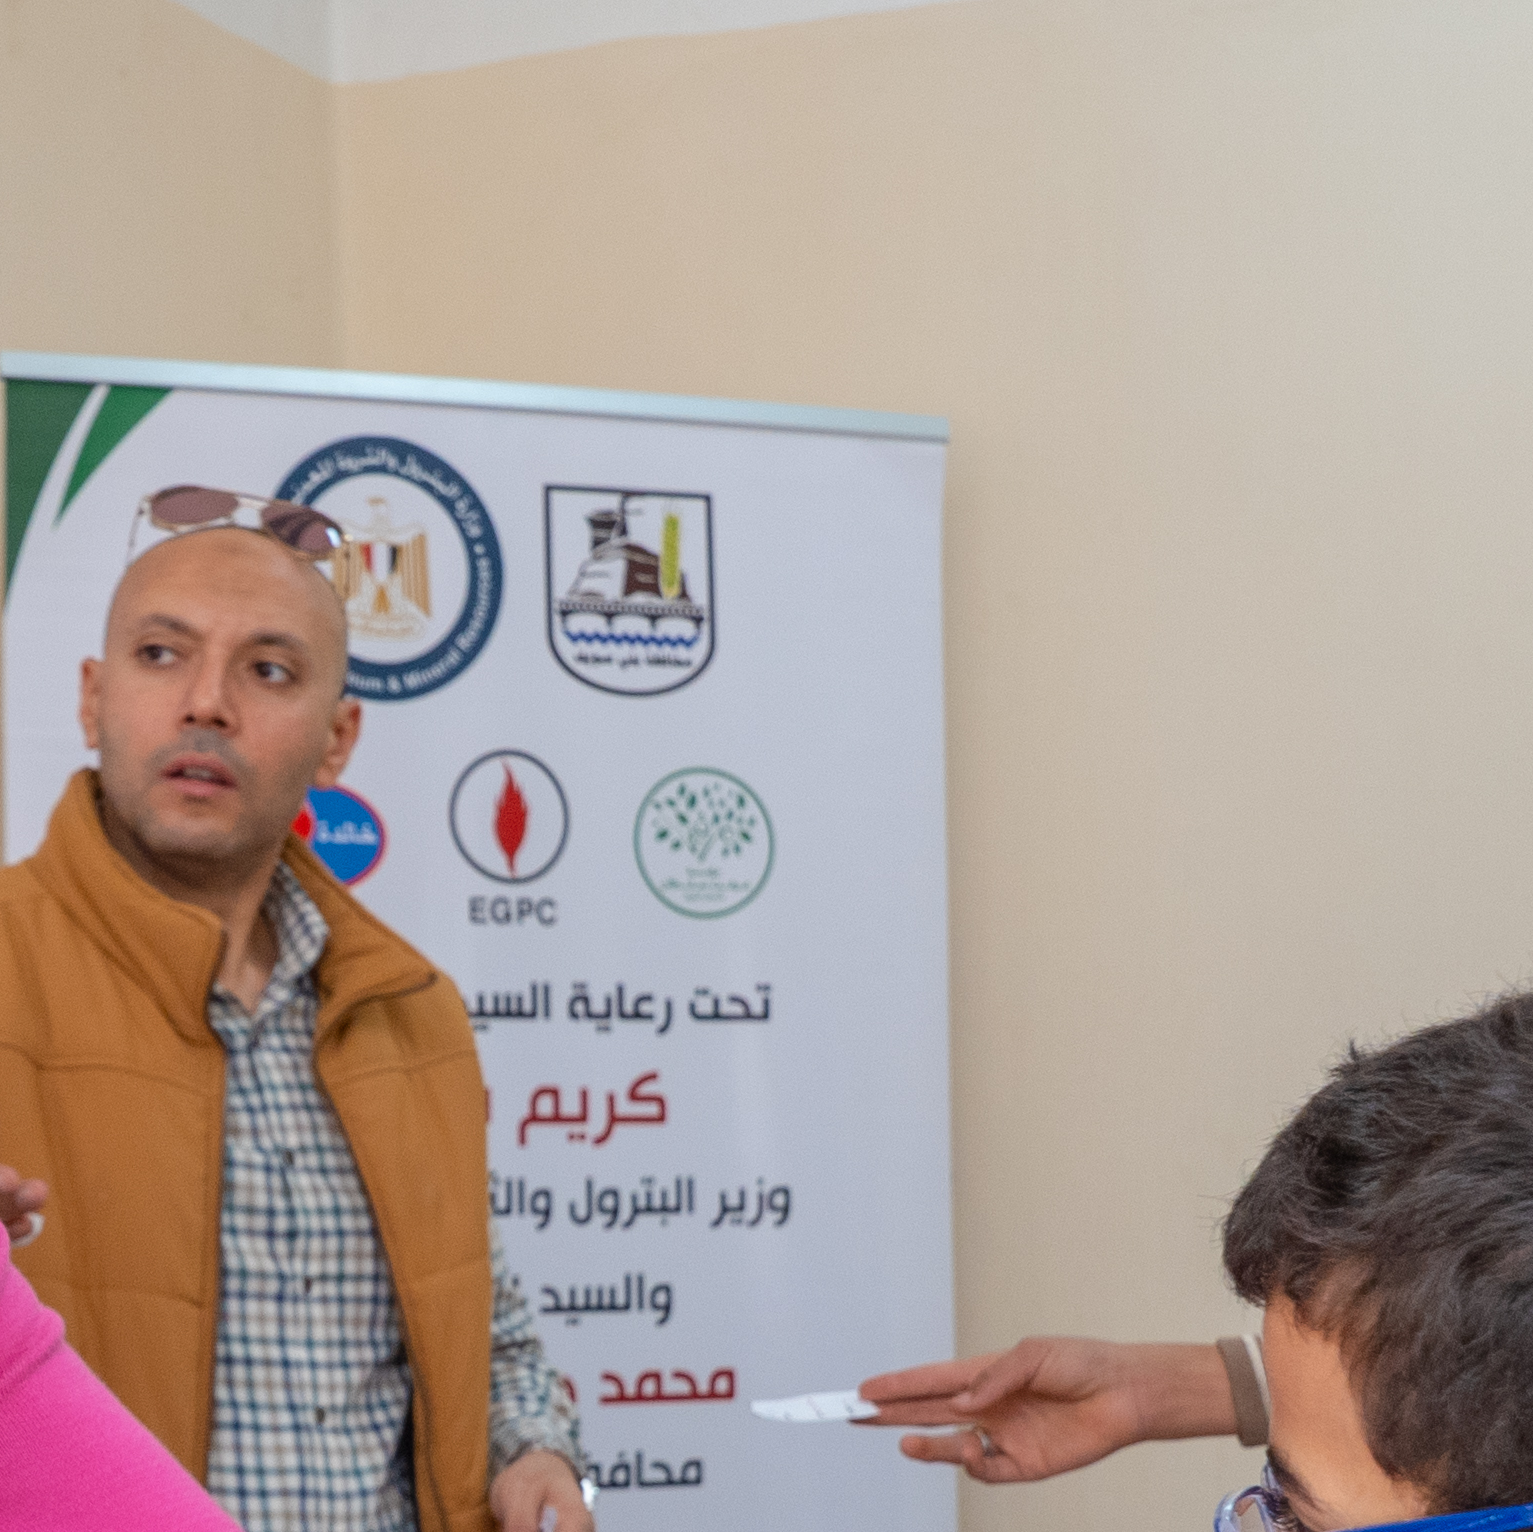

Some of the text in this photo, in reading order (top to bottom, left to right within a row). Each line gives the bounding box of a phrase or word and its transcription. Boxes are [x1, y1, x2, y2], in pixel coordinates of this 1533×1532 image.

[468, 896, 556, 926] EGPC
[467, 981, 771, 1036] تحت رعاية السي
[518, 1069, 667, 1147] كريم
[569, 1175, 694, 1230] البترول
[709, 1176, 791, 1228] وزير
[539, 1272, 673, 1327] والسيد
[598, 1368, 735, 1405] محمد
